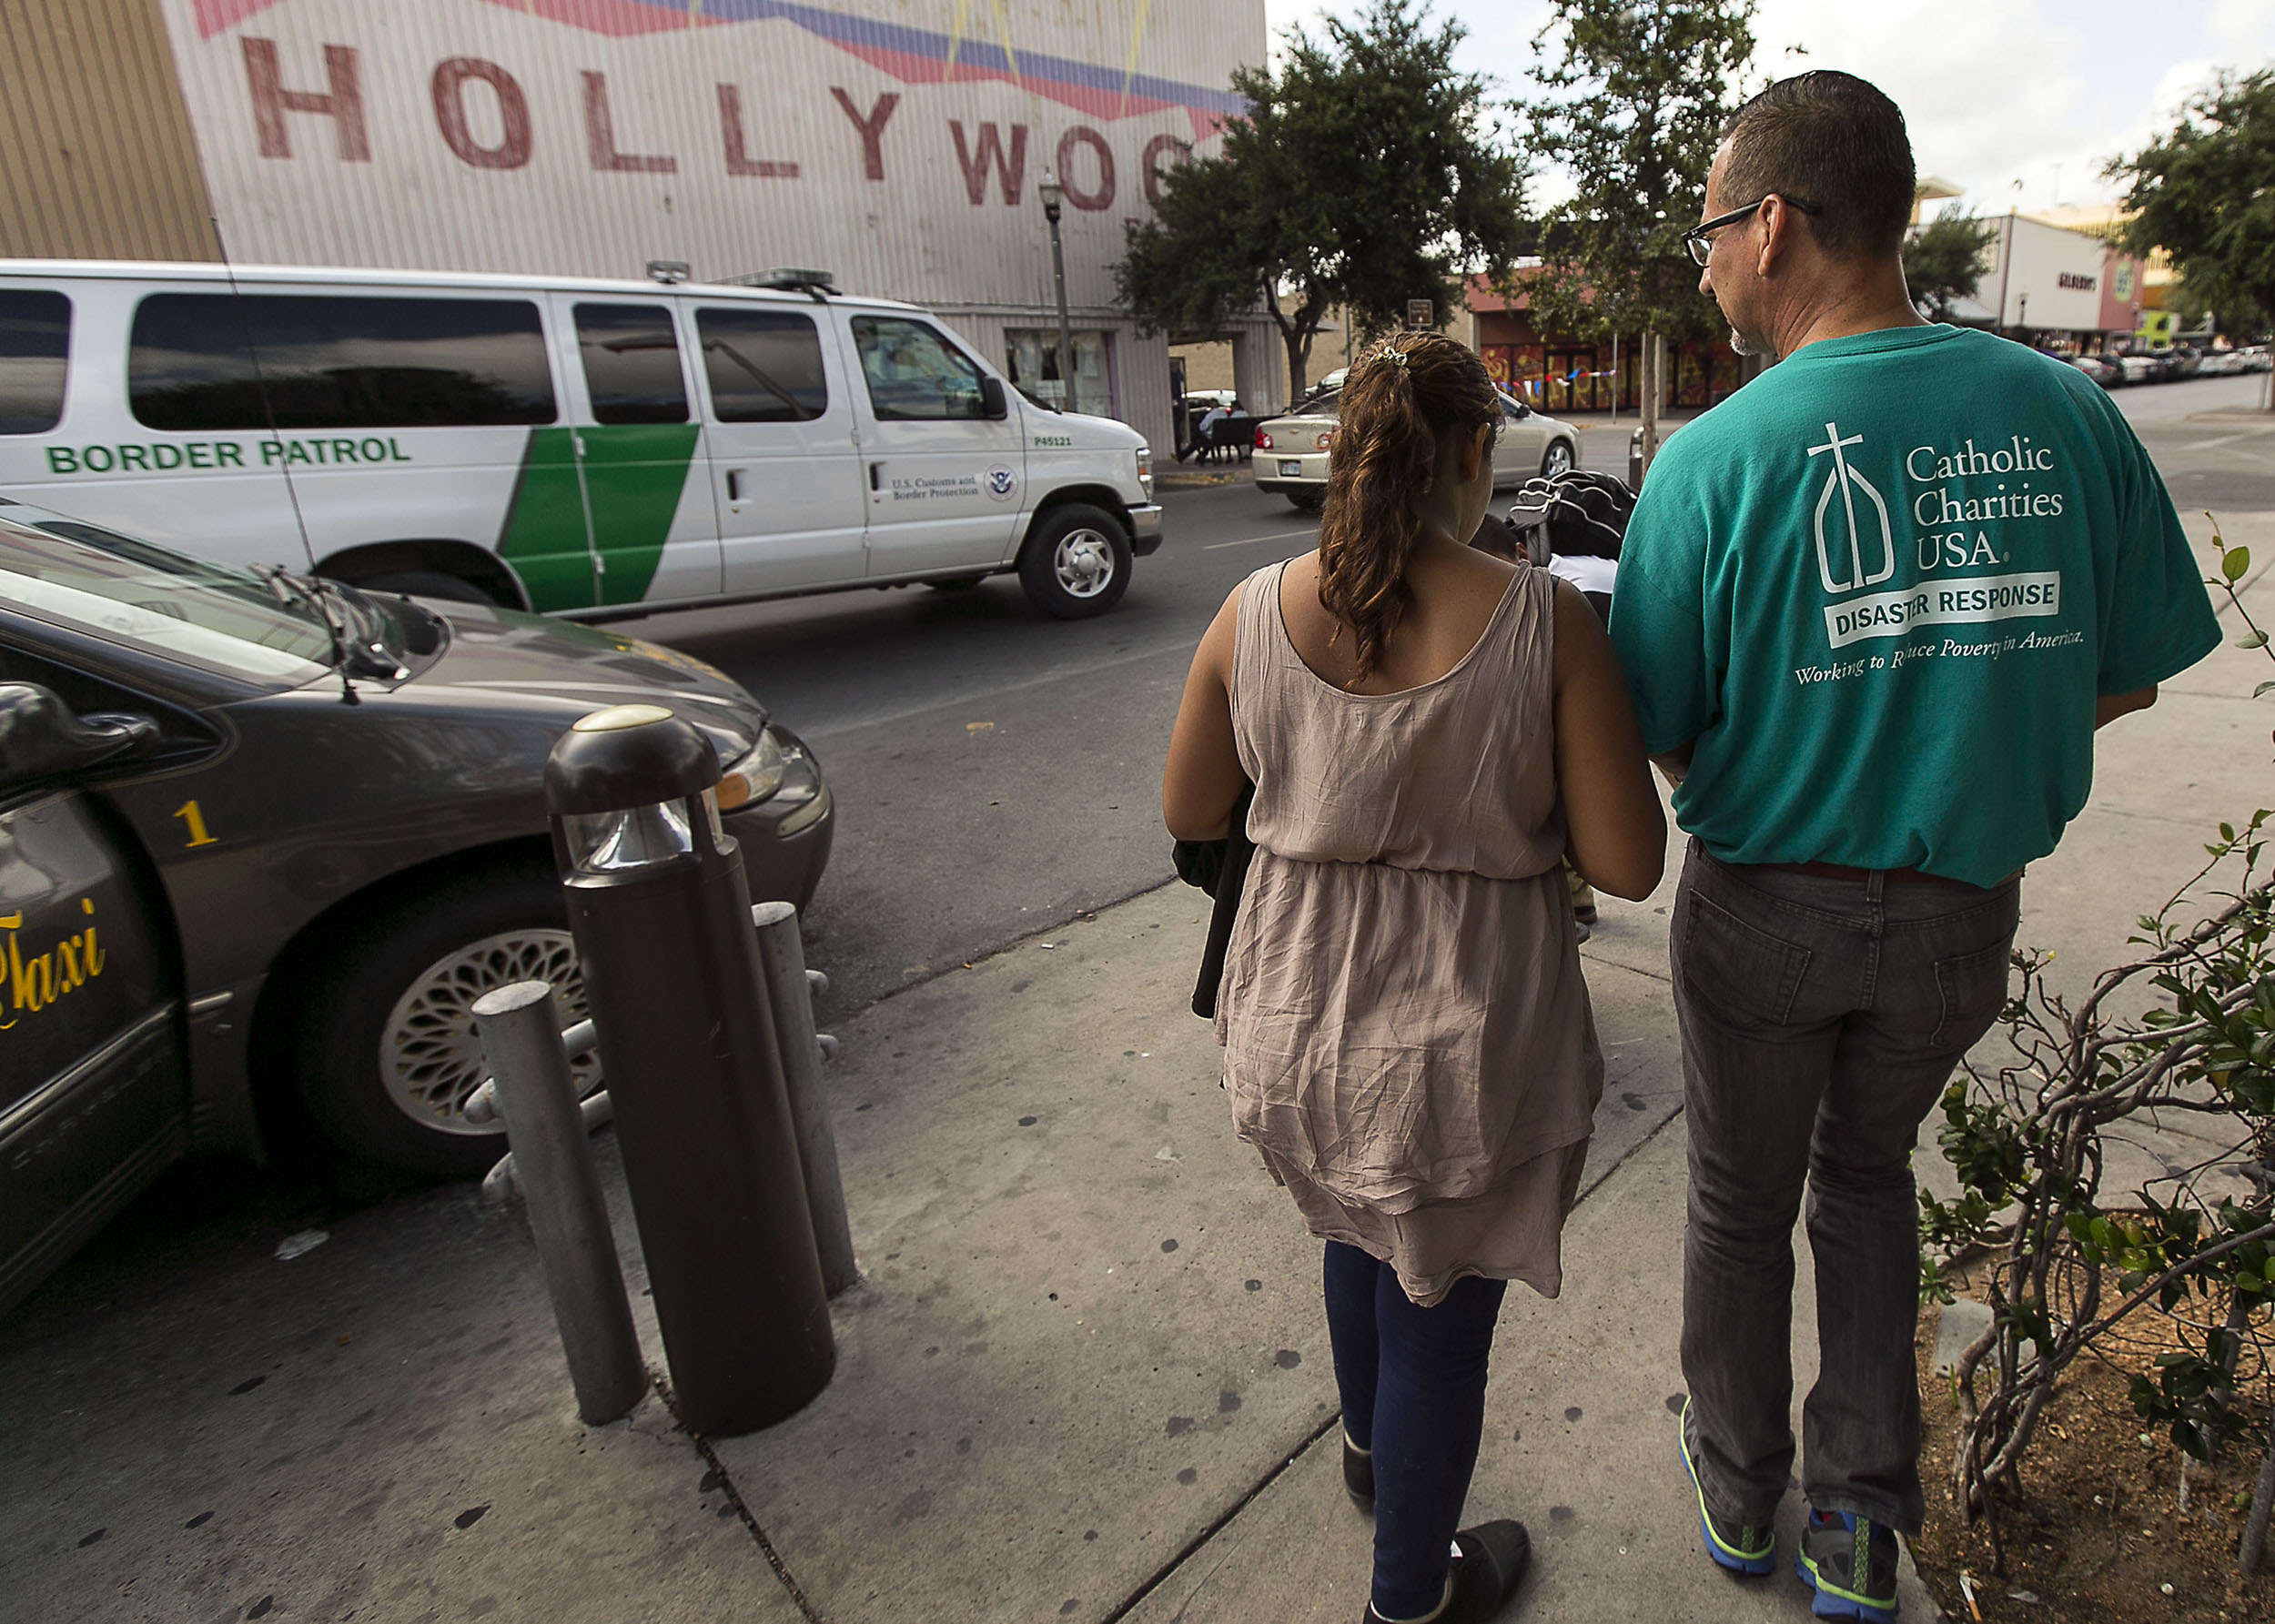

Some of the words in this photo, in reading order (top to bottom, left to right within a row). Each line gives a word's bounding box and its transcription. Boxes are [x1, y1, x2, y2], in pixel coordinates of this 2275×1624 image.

[46, 441, 245, 474] BORDER
[258, 437, 411, 466] PATROL
[1034, 436, 1071, 447] P45121
[1906, 435, 2054, 482] Catholic
[894, 489, 925, 500] Border
[929, 487, 978, 498] Protection
[915, 477, 956, 488] Customs
[958, 476, 976, 485] and
[1914, 482, 2063, 527] Charities
[1917, 530, 1999, 570] USA
[1835, 592, 1930, 637] DISASTER
[1939, 581, 2056, 613] RESPONSE
[1795, 657, 1865, 685] Working
[1869, 655, 1885, 670] to
[1890, 641, 1936, 670] Ruce
[172, 800, 218, 847] 1
